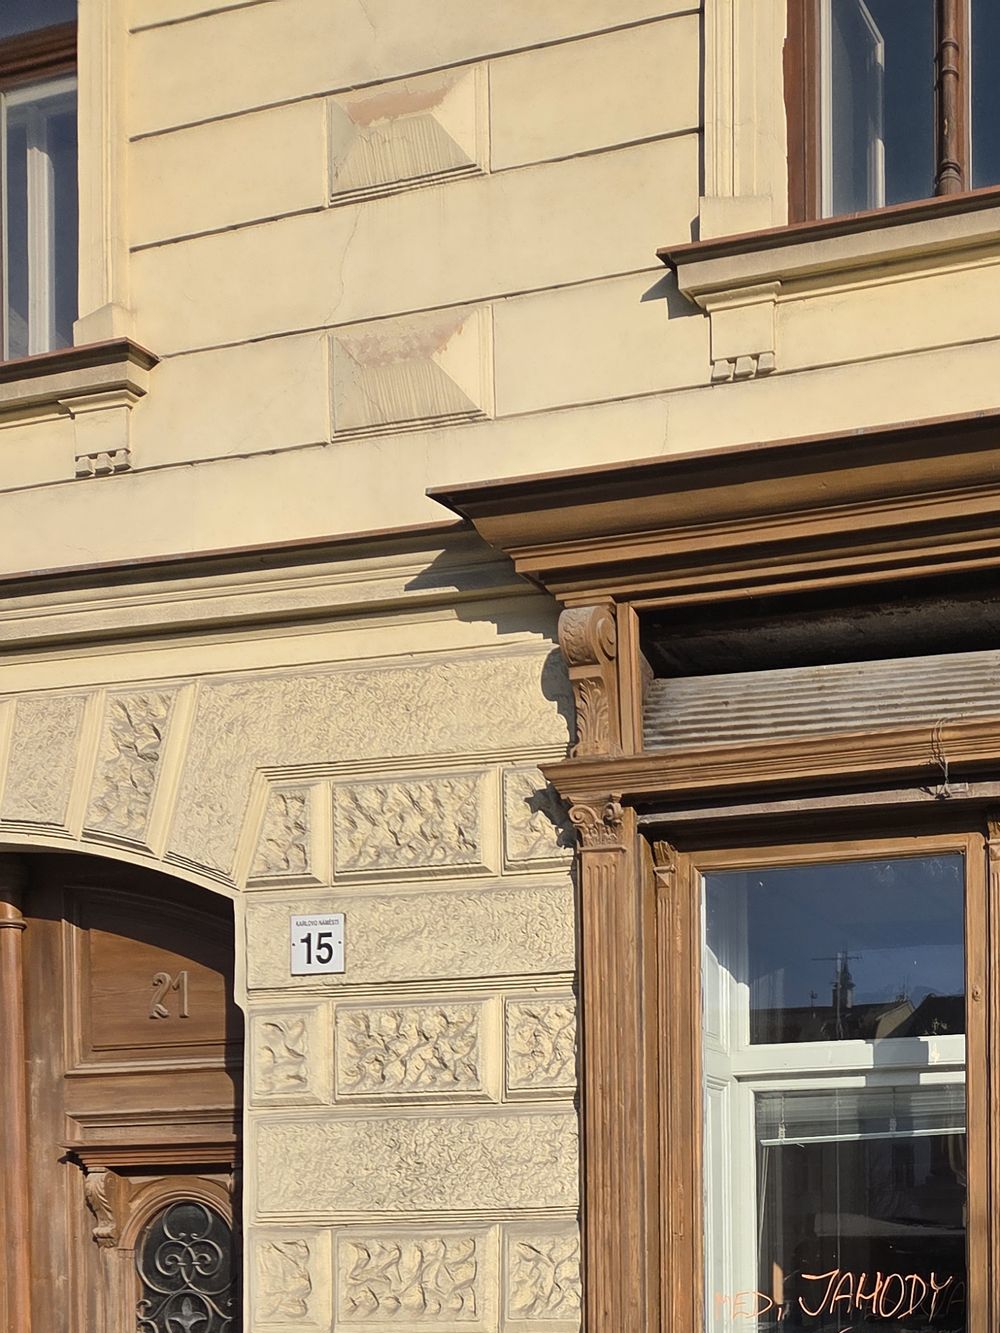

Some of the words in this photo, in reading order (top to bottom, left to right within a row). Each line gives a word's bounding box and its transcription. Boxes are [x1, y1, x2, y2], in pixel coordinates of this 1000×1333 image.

[300, 932, 334, 964] 15
[149, 970, 190, 1019] 21
[798, 1268, 954, 1323] JAHODY
